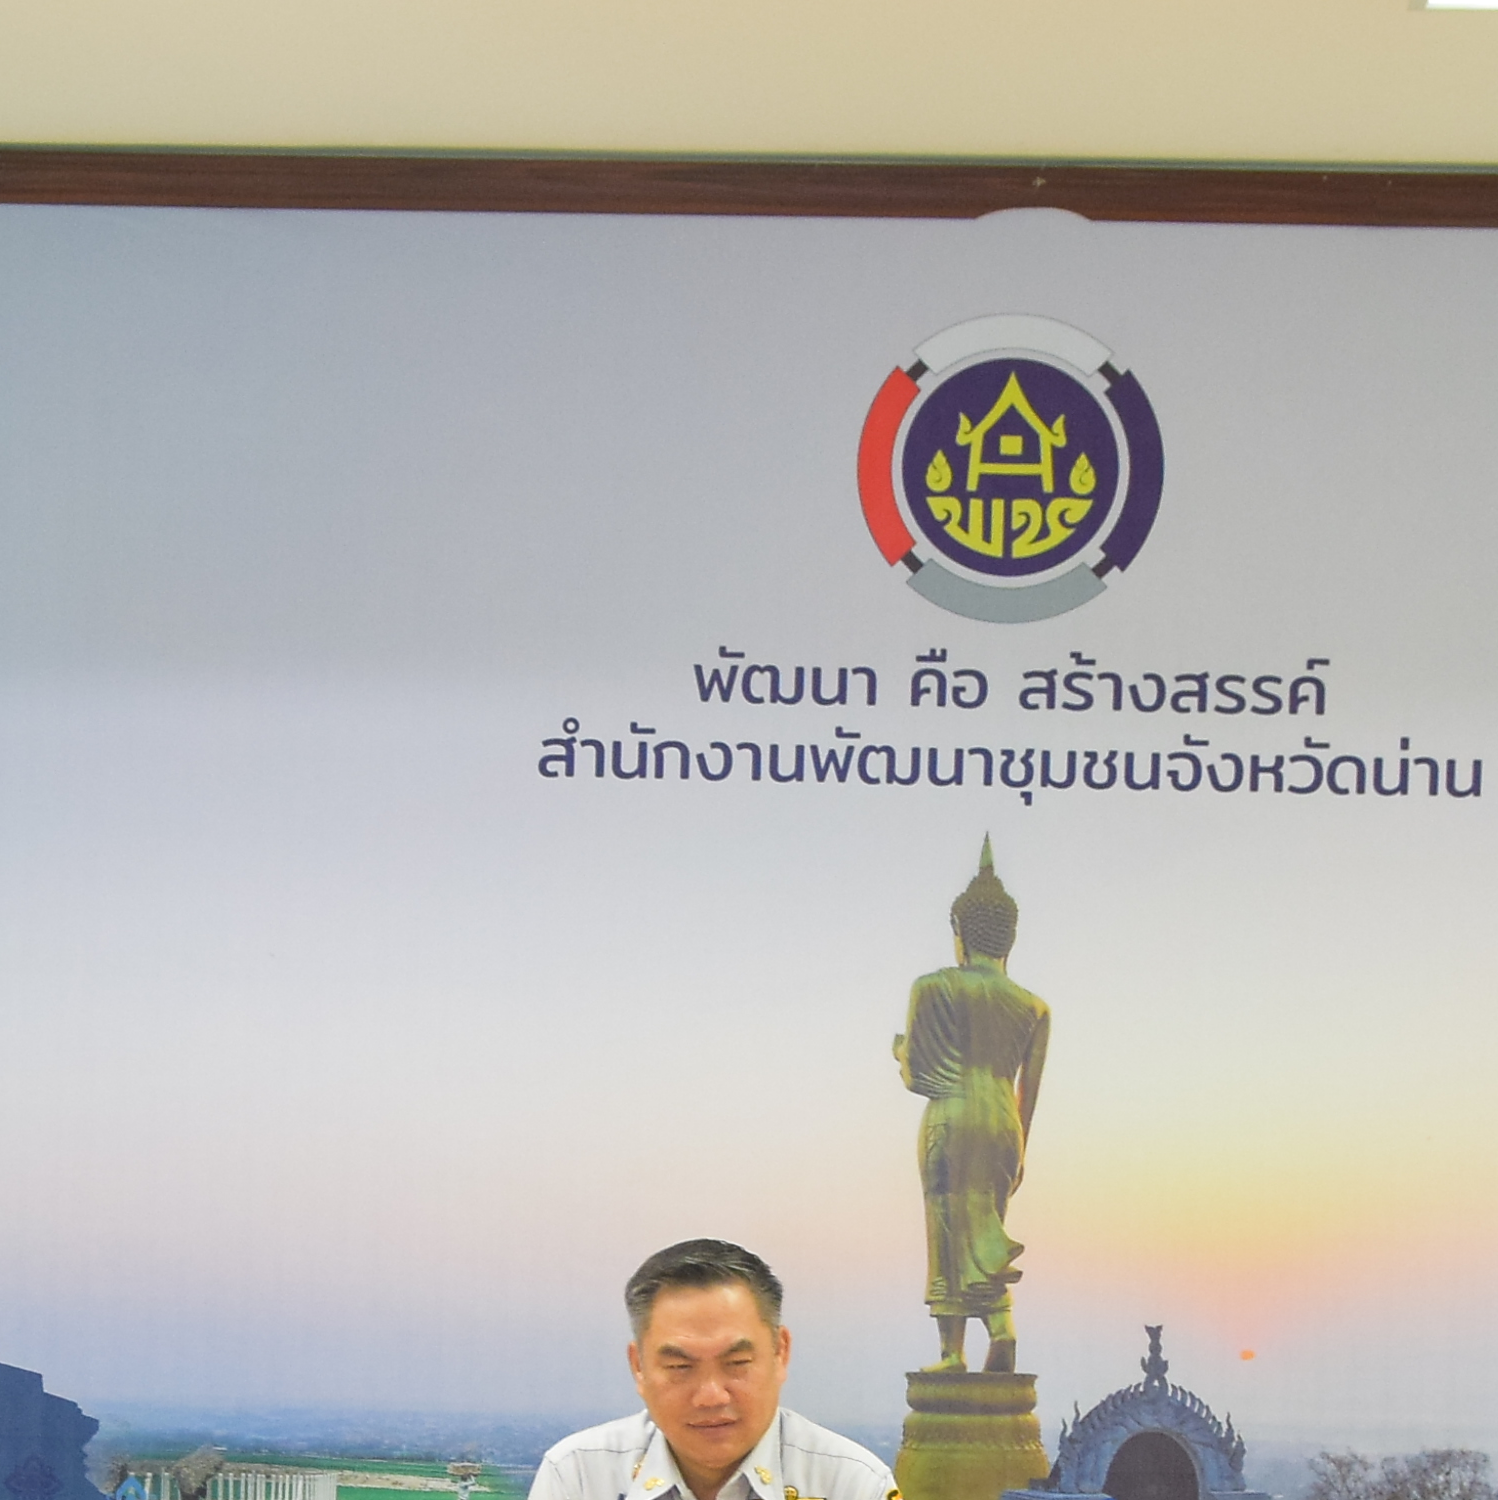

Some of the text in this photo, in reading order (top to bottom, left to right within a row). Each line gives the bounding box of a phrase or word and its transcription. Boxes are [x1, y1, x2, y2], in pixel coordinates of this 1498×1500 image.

[693, 645, 1331, 716] พัฒนา คือ สร้างสรรค์
[537, 716, 1484, 807] สำนักงานพัฒนาชุมชนจังหวัดน่าน
